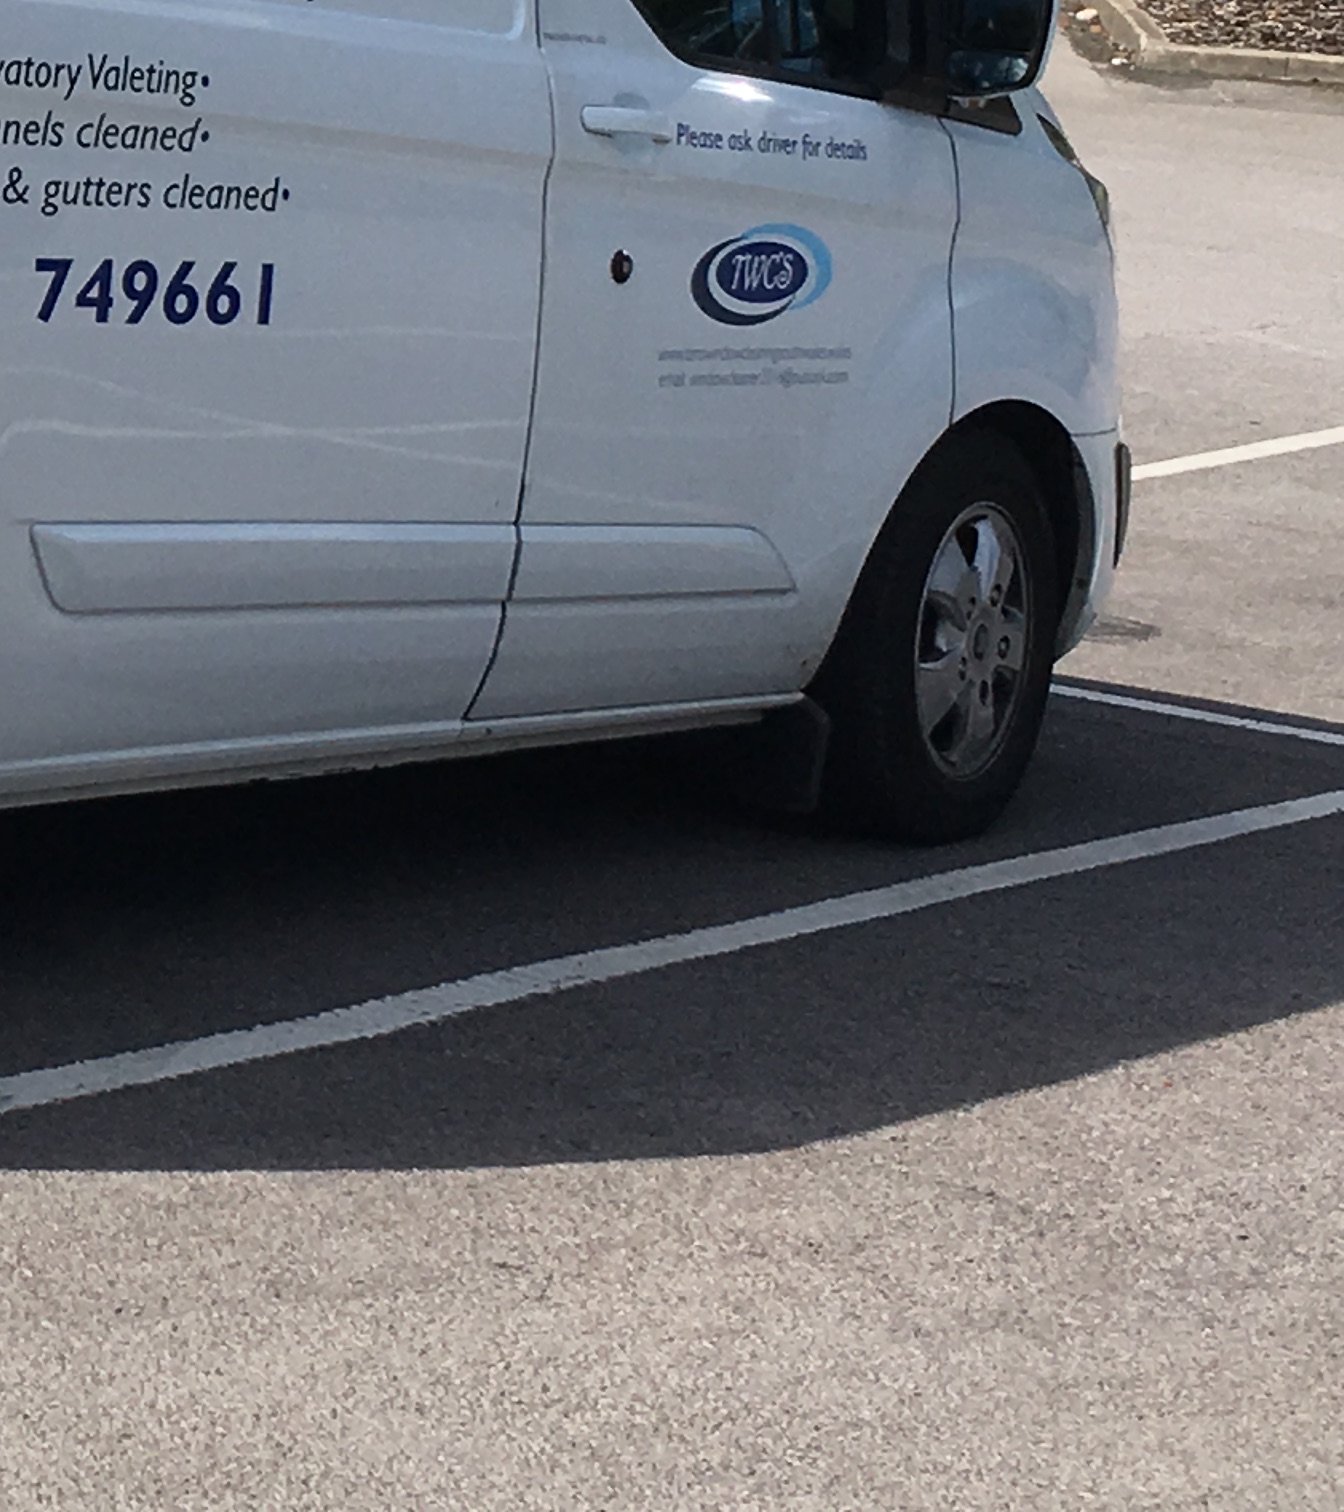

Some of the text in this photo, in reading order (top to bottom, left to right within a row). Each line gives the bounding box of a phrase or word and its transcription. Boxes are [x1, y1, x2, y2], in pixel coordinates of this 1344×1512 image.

[87, 53, 199, 106] Valeting
[76, 114, 201, 153] cleaned
[676, 122, 868, 161] Please ask driver for details
[2, 167, 29, 205] &
[41, 174, 151, 216] gutters
[163, 172, 280, 212] cleaned
[34, 257, 274, 326] 749661
[731, 251, 795, 291] TWCS
